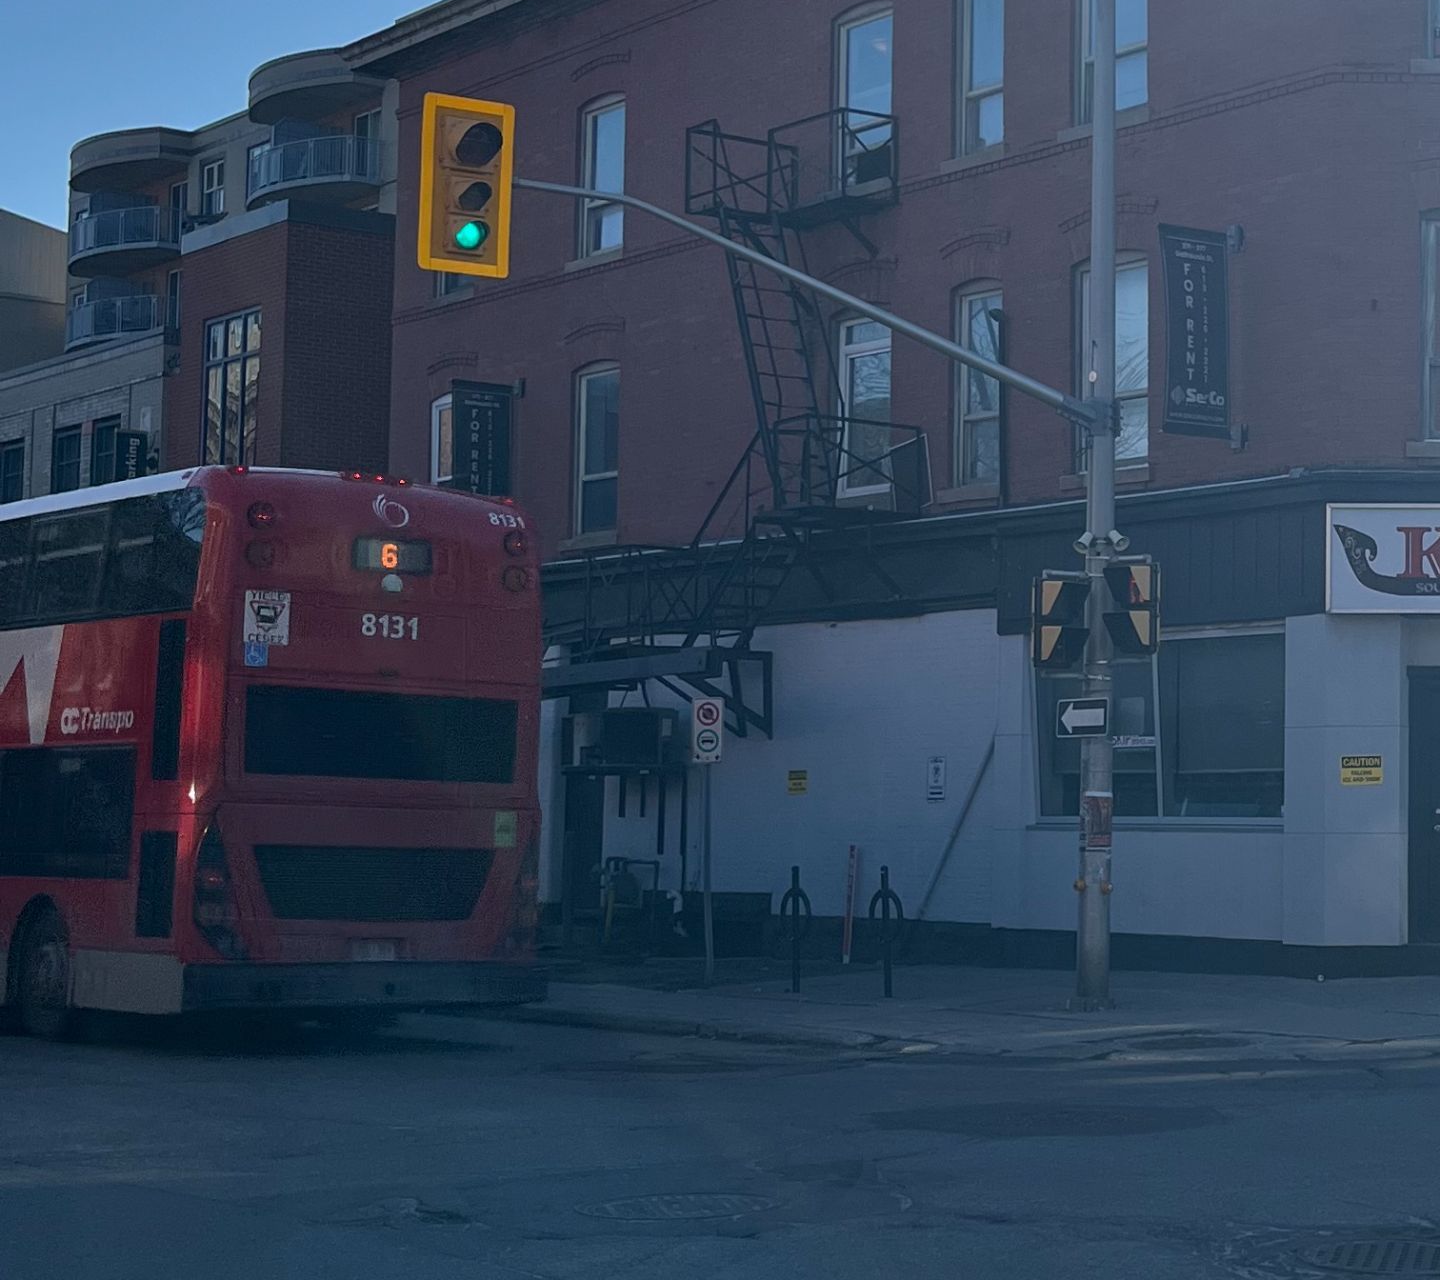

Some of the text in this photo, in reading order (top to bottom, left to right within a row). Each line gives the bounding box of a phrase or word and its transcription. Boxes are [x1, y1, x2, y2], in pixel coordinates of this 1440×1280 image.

[1183, 263, 1194, 309] FOR
[1186, 318, 1196, 381] RENT
[470, 408, 480, 443] FOR
[125, 438, 141, 479] arking
[487, 512, 526, 529] 8131
[380, 543, 399, 570] 6
[361, 613, 419, 641] 8131
[81, 707, 134, 734] Transpo
[1343, 758, 1380, 767] CAUTION
